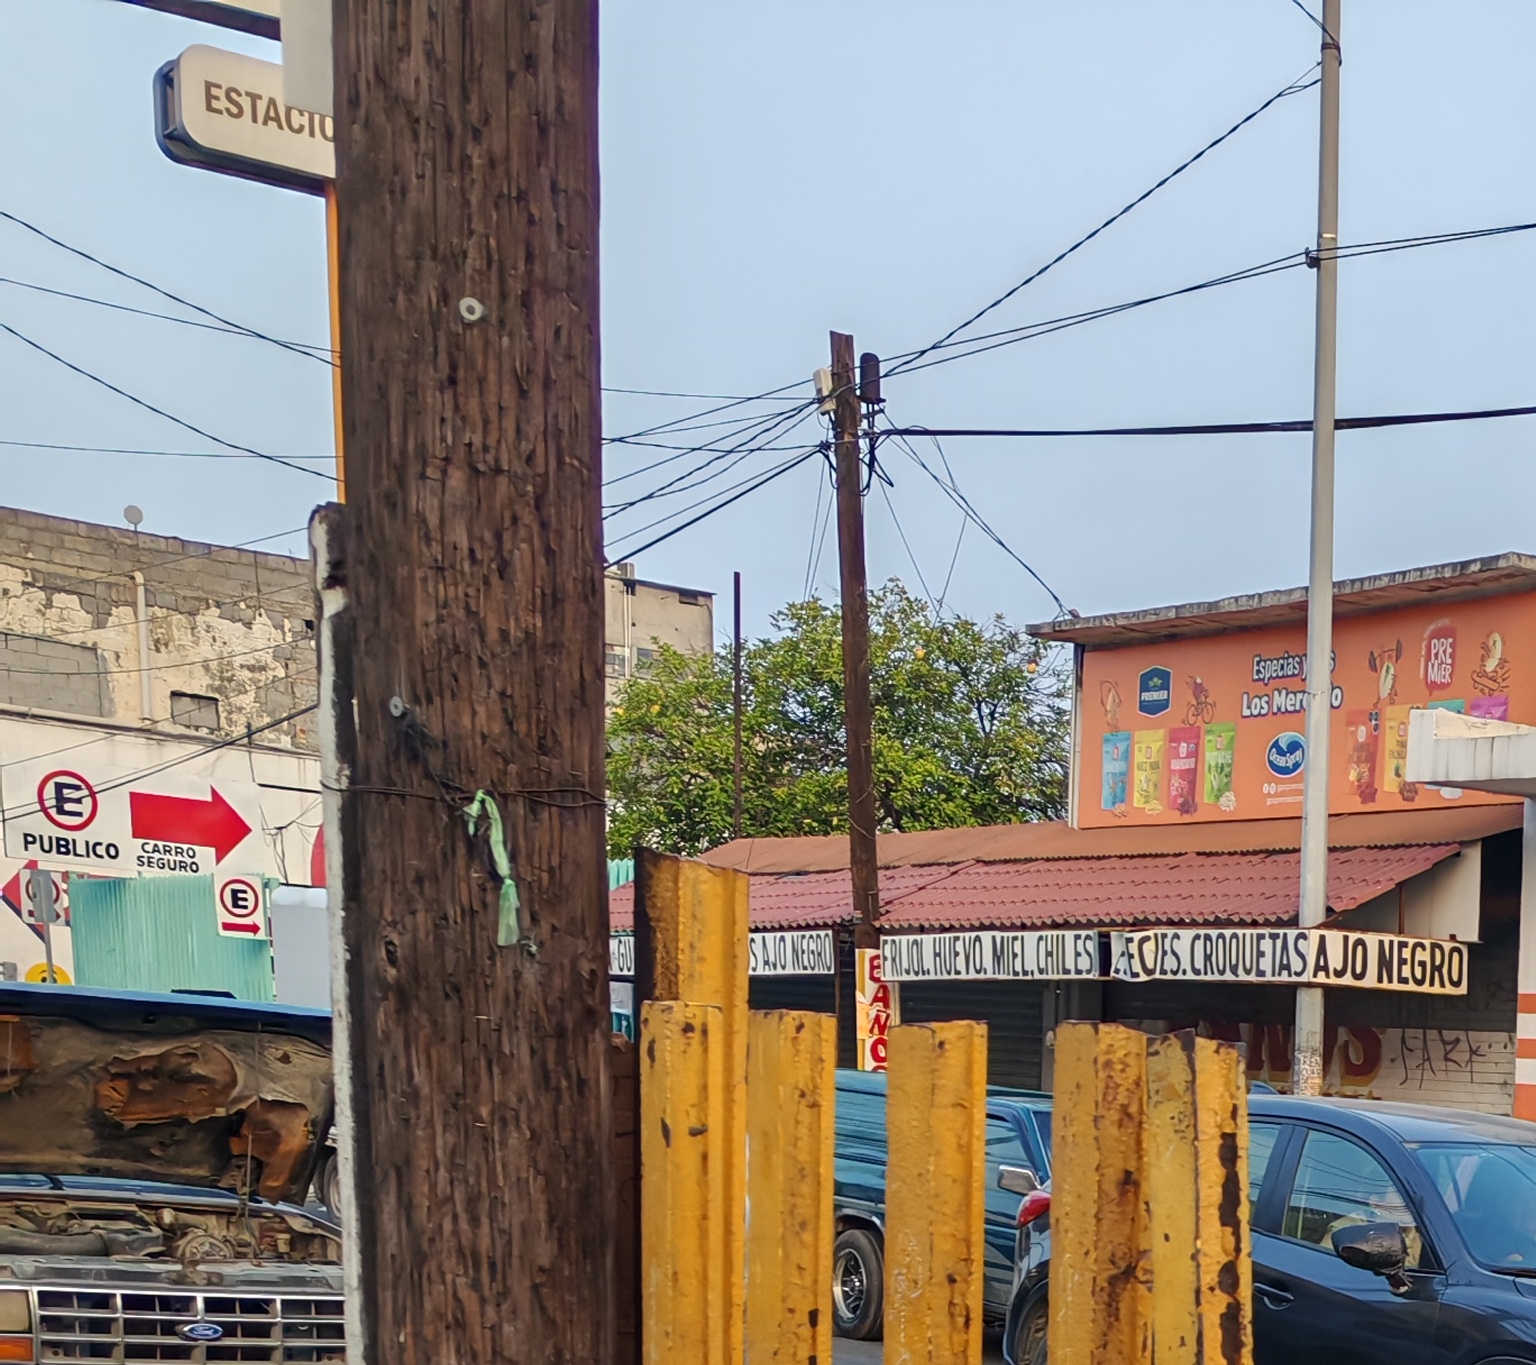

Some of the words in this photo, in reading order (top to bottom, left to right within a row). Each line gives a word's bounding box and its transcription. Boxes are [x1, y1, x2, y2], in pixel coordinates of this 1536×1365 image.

[1431, 637, 1453, 664] PRE
[1252, 652, 1301, 684] Especias
[1242, 692, 1269, 717] Los
[54, 781, 84, 818] E
[23, 832, 120, 860] PUBLICO
[140, 841, 197, 859] CARRO
[136, 855, 200, 873] SEGURO
[231, 888, 249, 910] E
[762, 936, 787, 973] AJO
[792, 932, 833, 973] NEGRO
[1190, 932, 1308, 978] CROQUETAS
[1312, 934, 1368, 980] AJO
[1377, 939, 1464, 989] NEGRO
